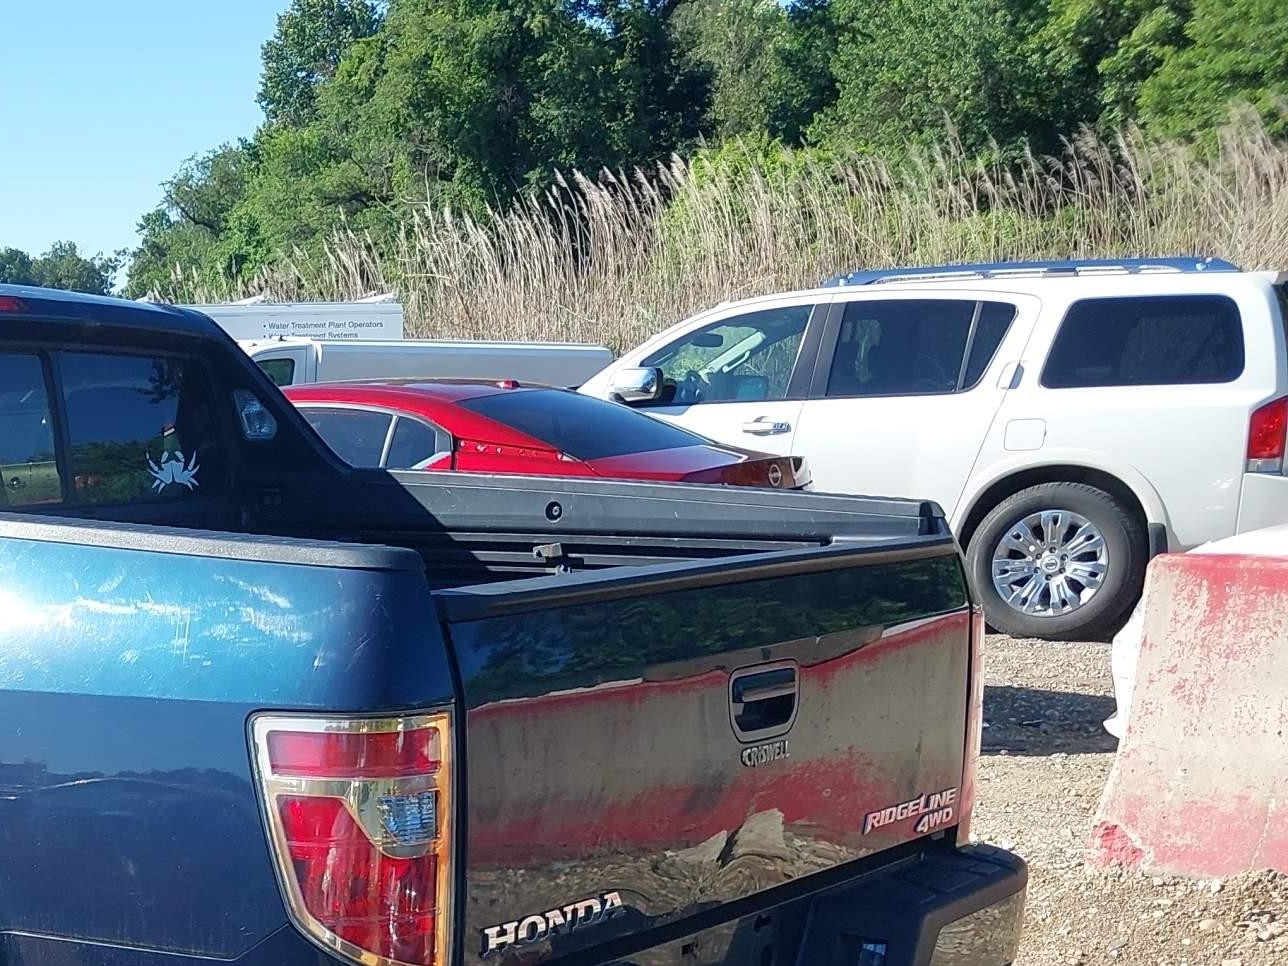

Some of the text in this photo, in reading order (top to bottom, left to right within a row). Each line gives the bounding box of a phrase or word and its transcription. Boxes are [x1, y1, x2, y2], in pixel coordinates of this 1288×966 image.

[268, 322, 289, 330] Water
[328, 321, 346, 329] Plant
[348, 321, 384, 329] Operators
[914, 807, 953, 833] 4WD
[482, 891, 625, 957] HONDA
